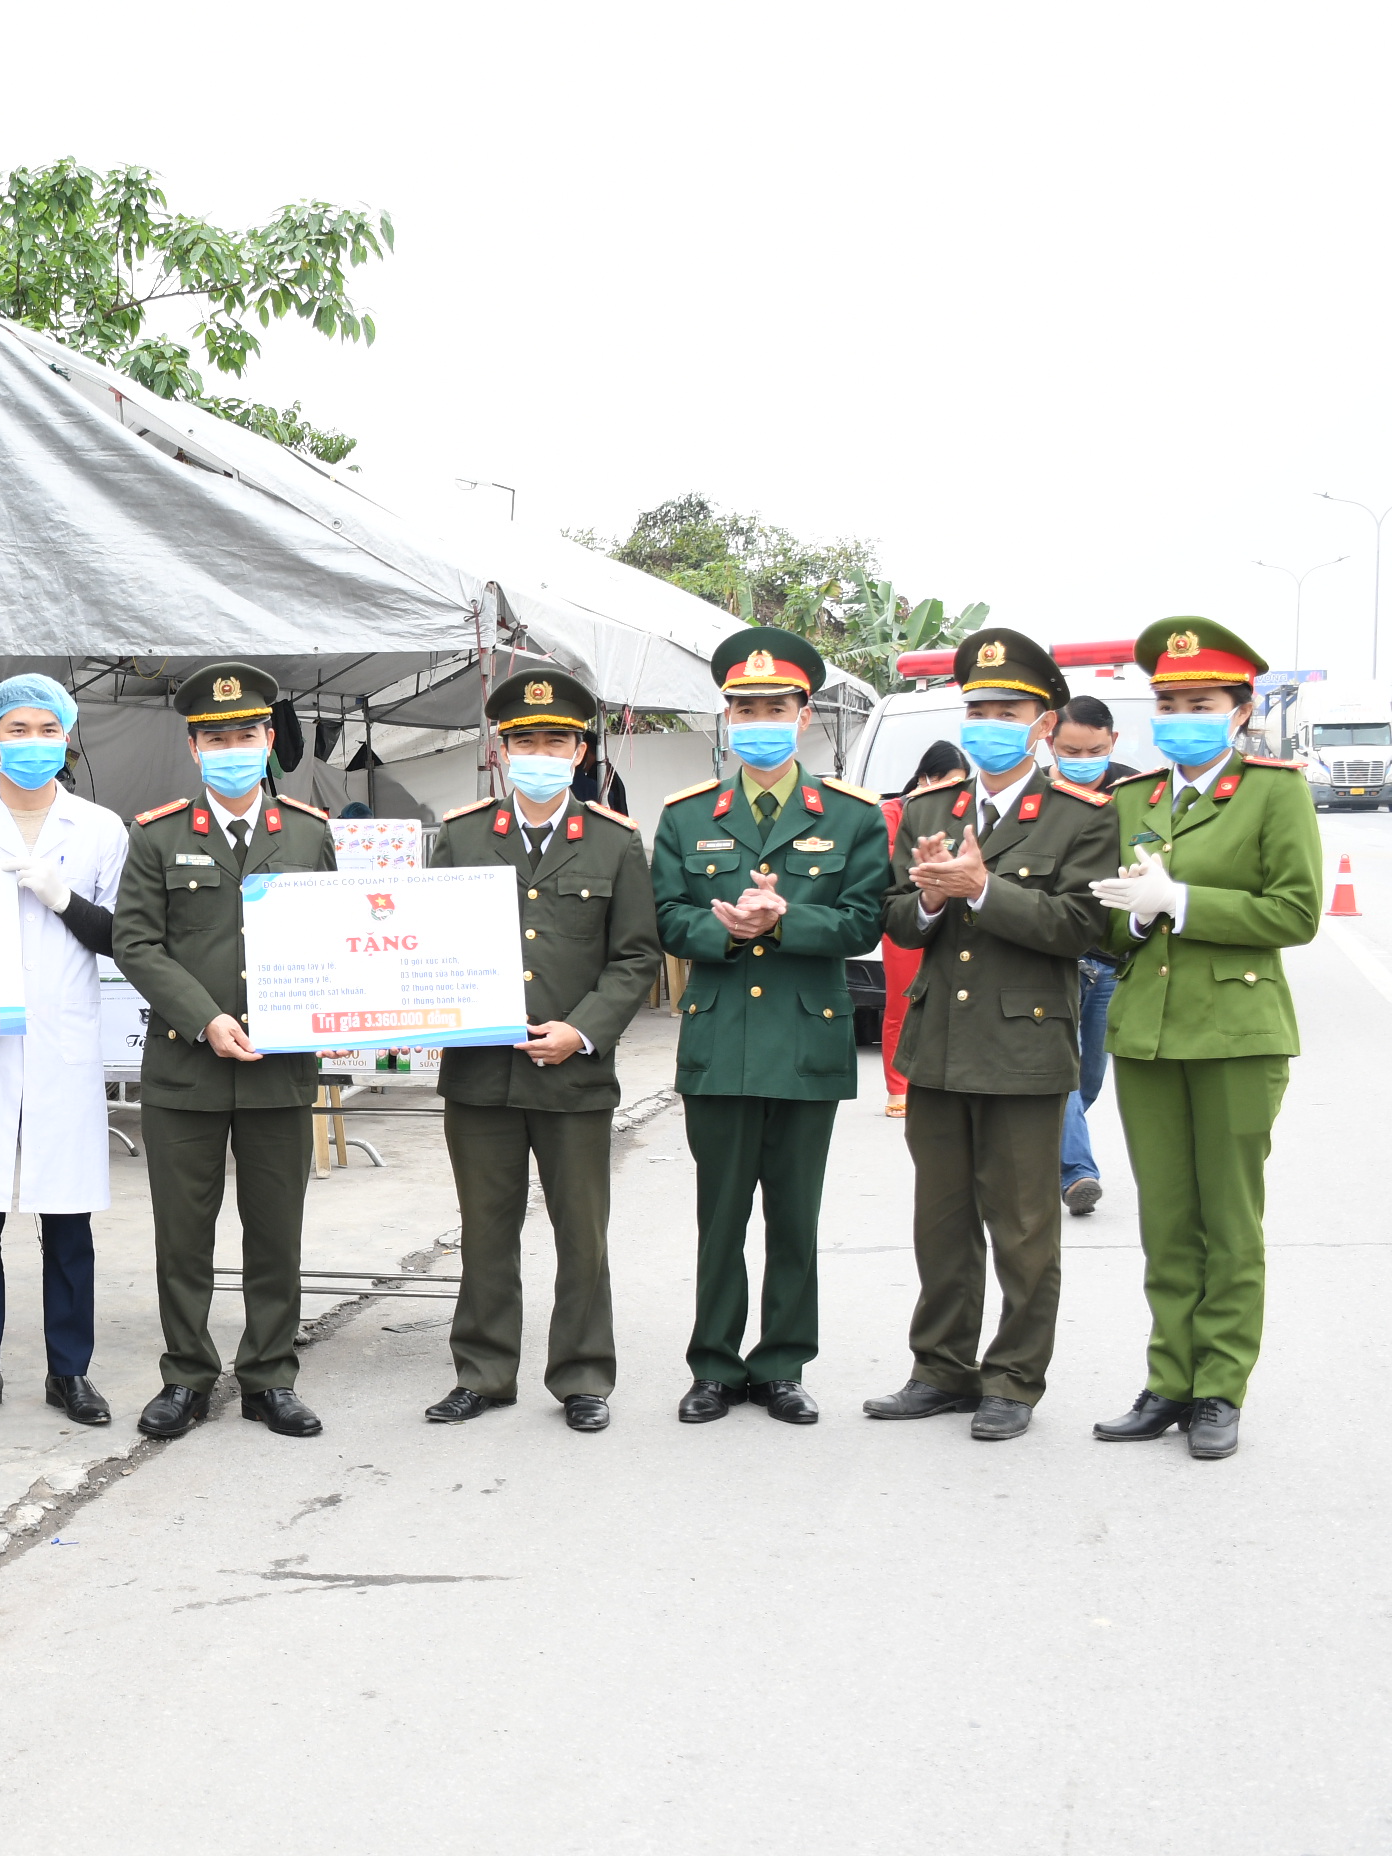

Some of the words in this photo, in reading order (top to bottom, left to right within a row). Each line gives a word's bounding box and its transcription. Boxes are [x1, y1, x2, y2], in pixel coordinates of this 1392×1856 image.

[346, 932, 419, 957] TẶNG
[317, 1013, 335, 1032] Trị
[339, 1013, 360, 1031] giá
[364, 1011, 423, 1027] 3.360.000
